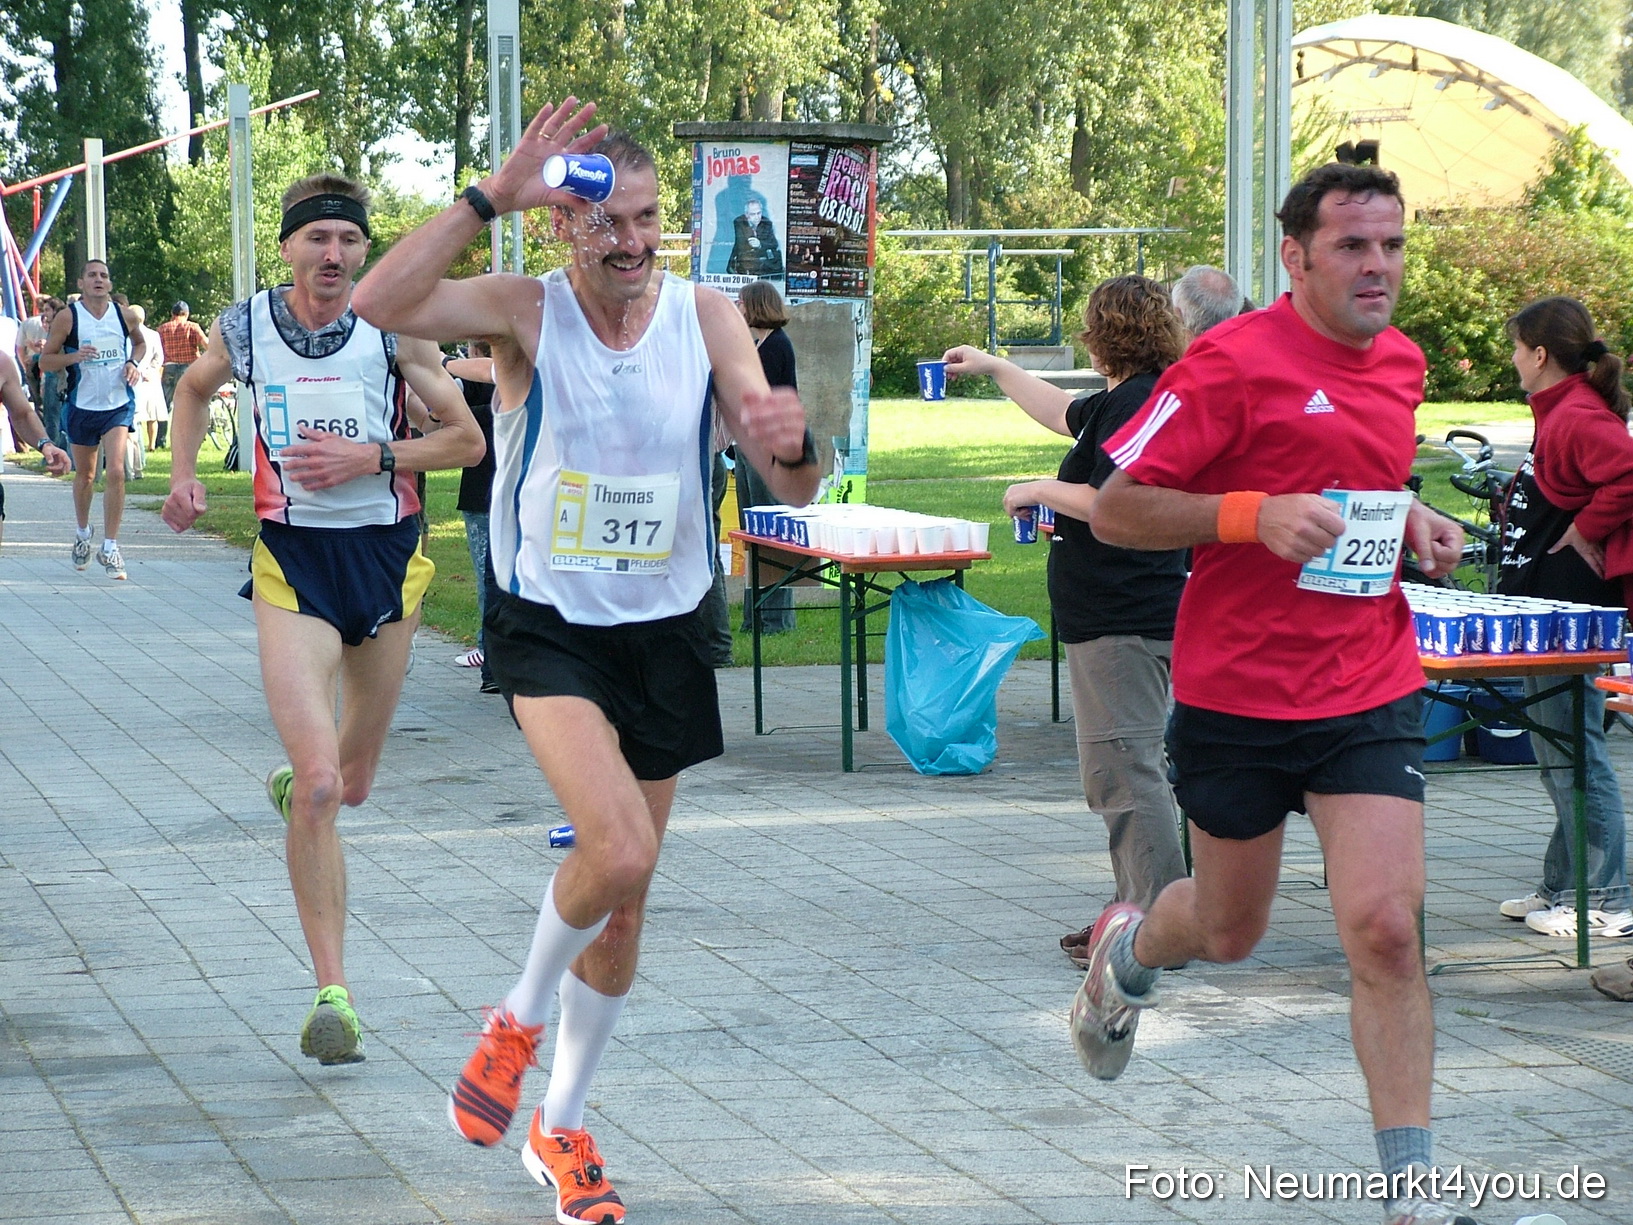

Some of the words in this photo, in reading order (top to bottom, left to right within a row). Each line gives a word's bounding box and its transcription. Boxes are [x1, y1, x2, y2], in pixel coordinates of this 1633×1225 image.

[713, 147, 741, 159] Bruno
[706, 155, 761, 186] Jonas
[818, 196, 866, 235] 08.09.07
[594, 483, 655, 505] Thomas
[560, 508, 568, 523] A
[1349, 501, 1398, 521] Manfred
[601, 518, 662, 546] 317
[552, 554, 601, 567] BOCK
[1342, 538, 1398, 567] 2285
[1526, 618, 1540, 652] Xenofit
[1565, 617, 1578, 651] Xenofit
